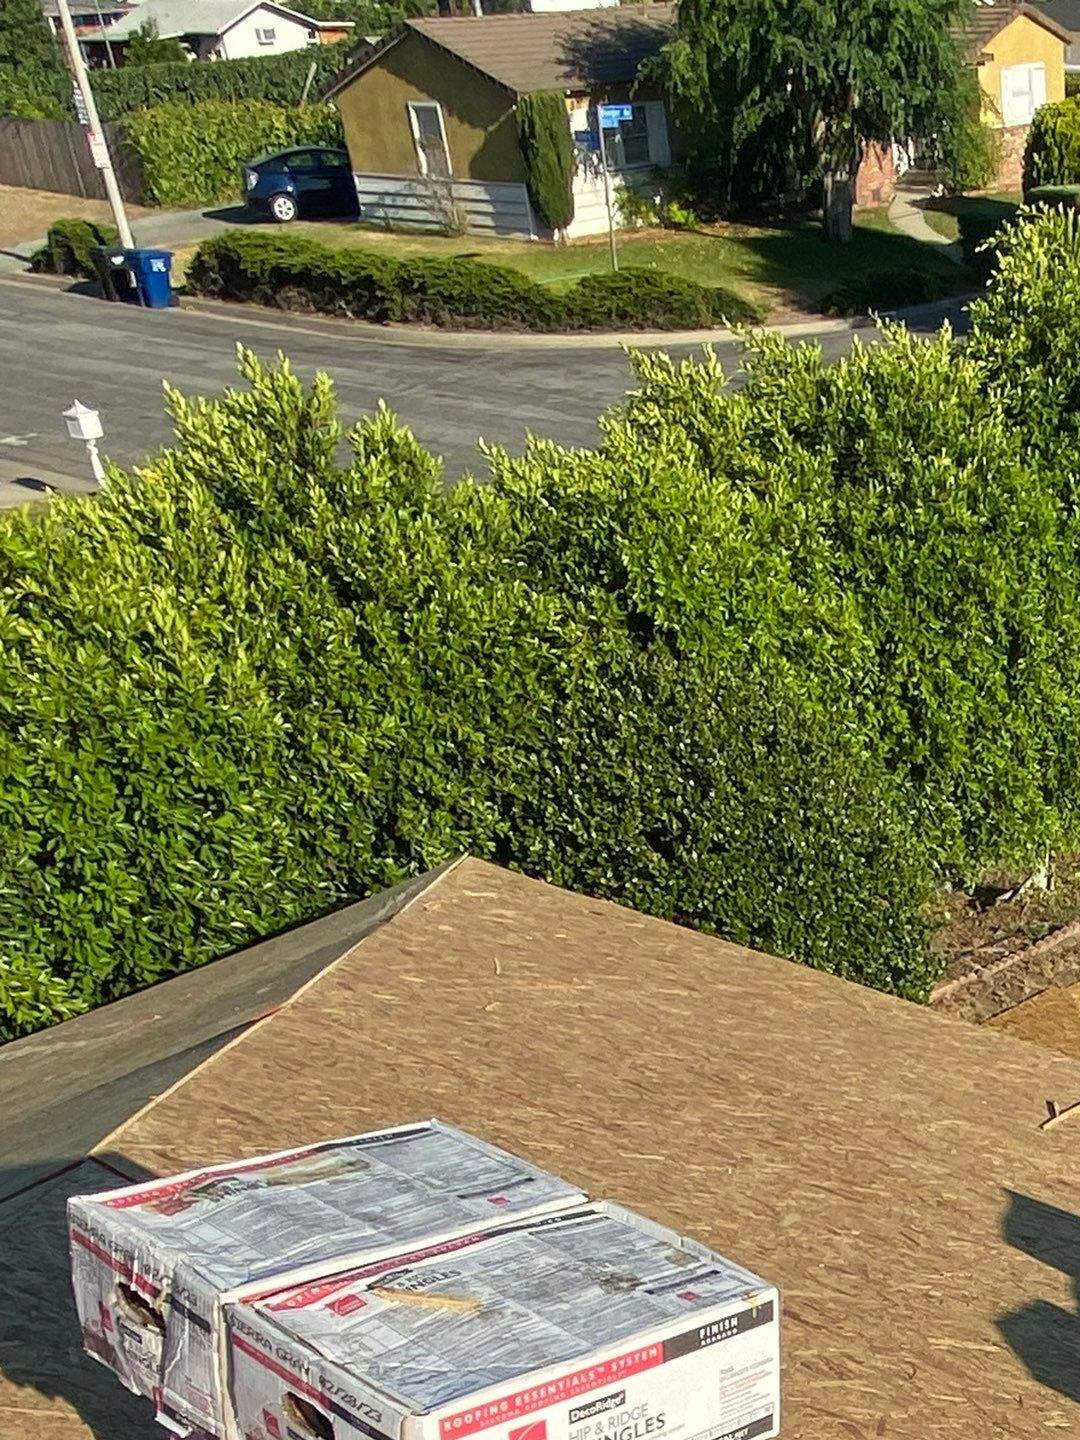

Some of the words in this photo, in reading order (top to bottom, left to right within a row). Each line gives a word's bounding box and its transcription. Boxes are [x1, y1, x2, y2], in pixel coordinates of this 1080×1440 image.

[443, 1401, 508, 1431] ROOFING
[611, 1346, 657, 1372] SYSTEM
[594, 1421, 605, 1436] &
[607, 1402, 648, 1430] RIDGE
